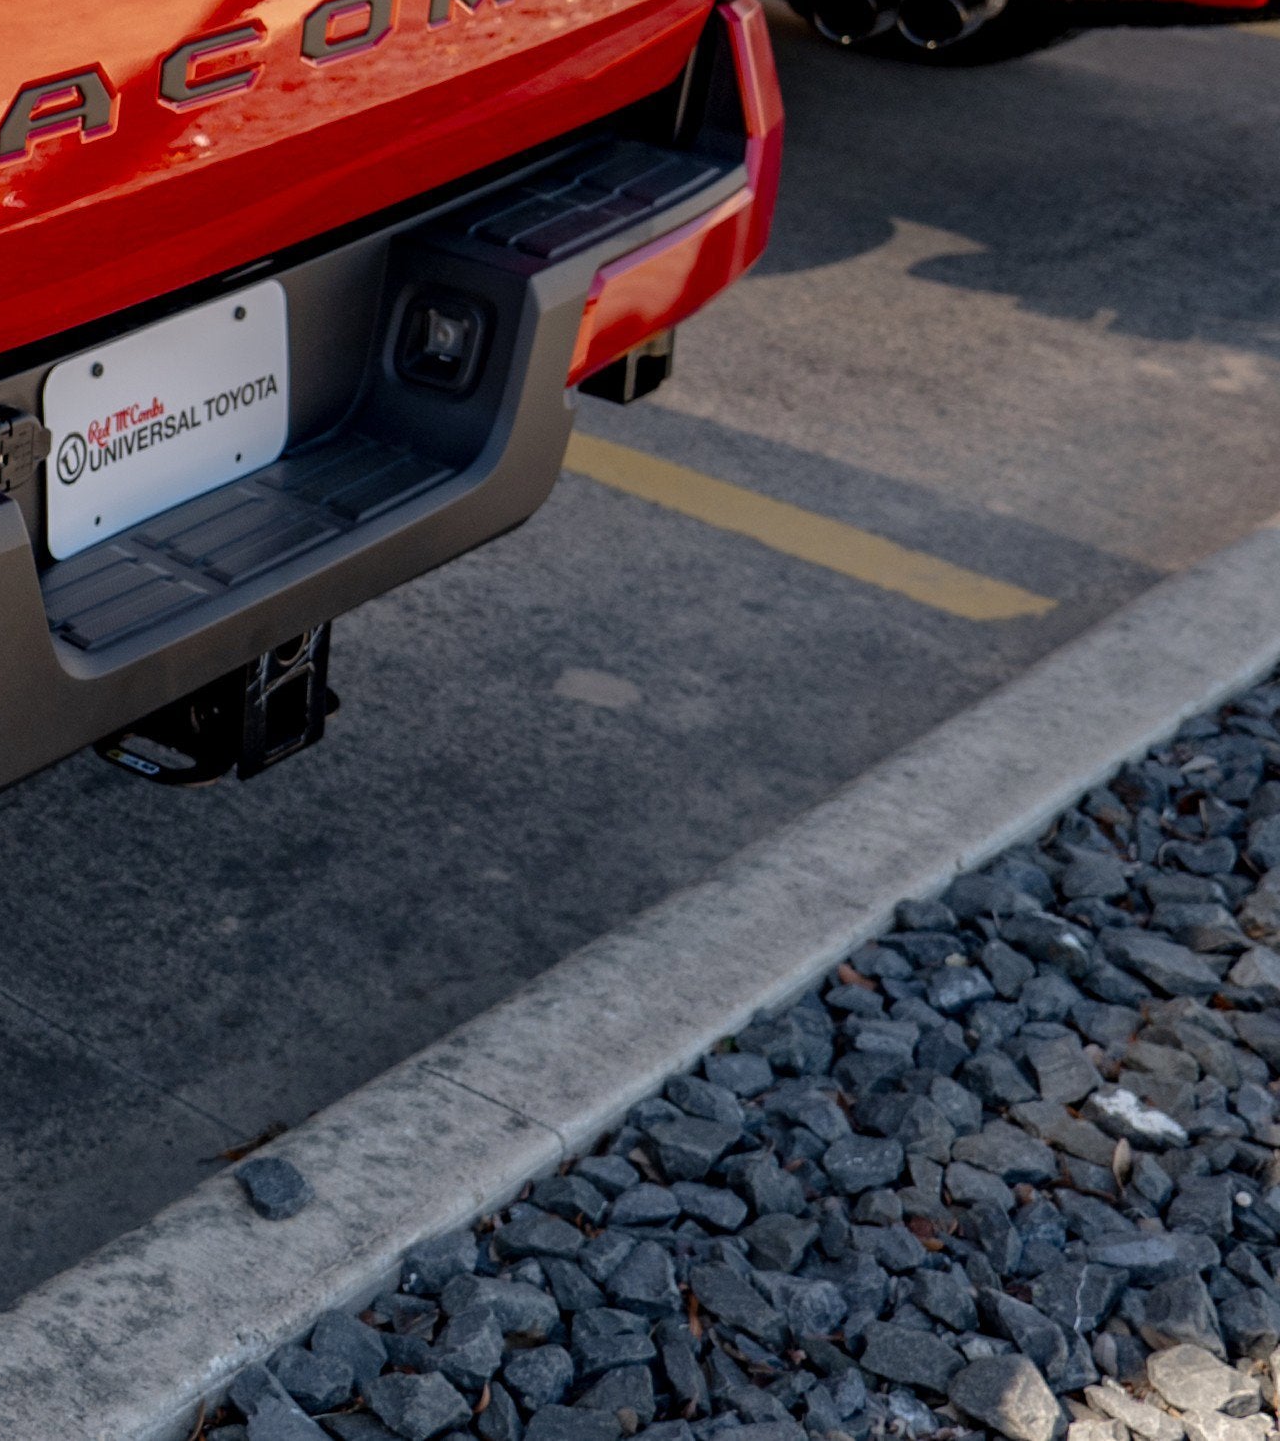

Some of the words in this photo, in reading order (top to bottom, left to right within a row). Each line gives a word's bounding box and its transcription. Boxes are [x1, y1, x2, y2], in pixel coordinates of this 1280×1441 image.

[87, 415, 111, 448] Red
[89, 406, 201, 472] UNIVERSAL
[203, 374, 278, 421] TOYOTA
